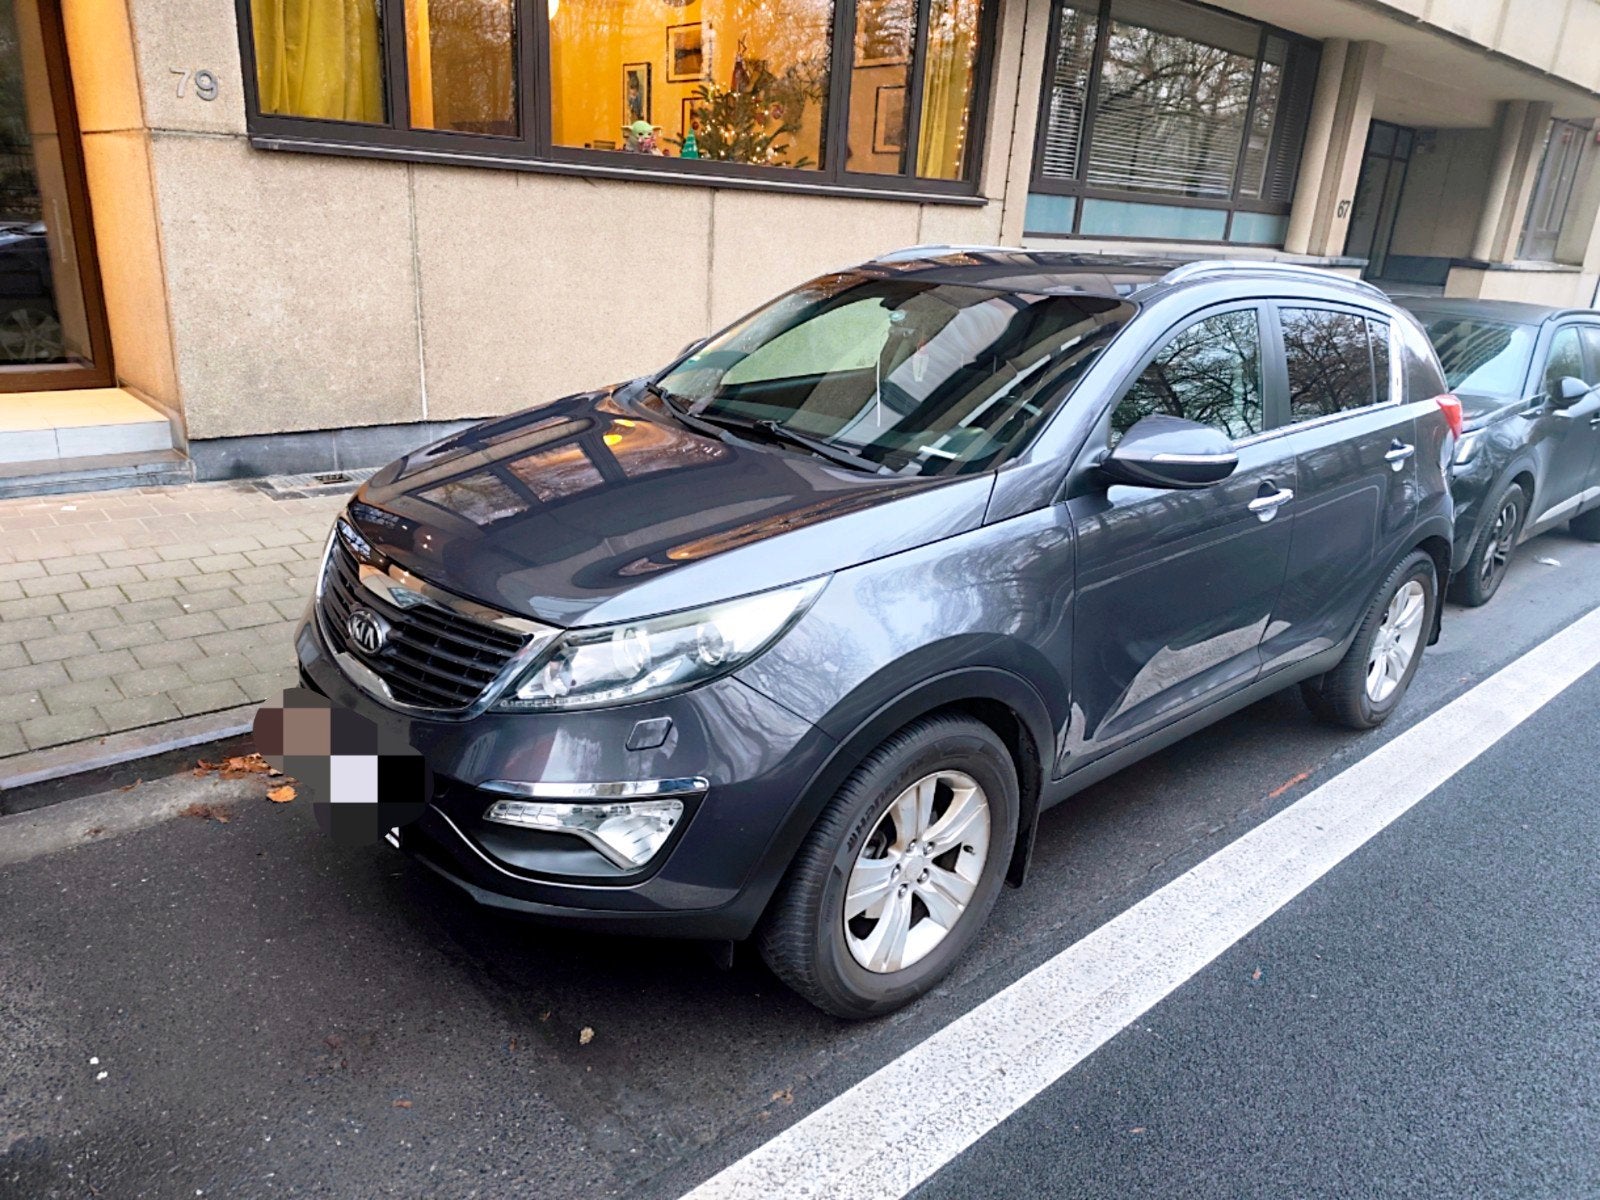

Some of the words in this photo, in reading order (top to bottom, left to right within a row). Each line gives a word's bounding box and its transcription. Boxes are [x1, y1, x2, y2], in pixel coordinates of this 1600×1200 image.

[169, 67, 219, 101] 79
[1337, 200, 1351, 219] 67
[351, 615, 375, 651] KIA
